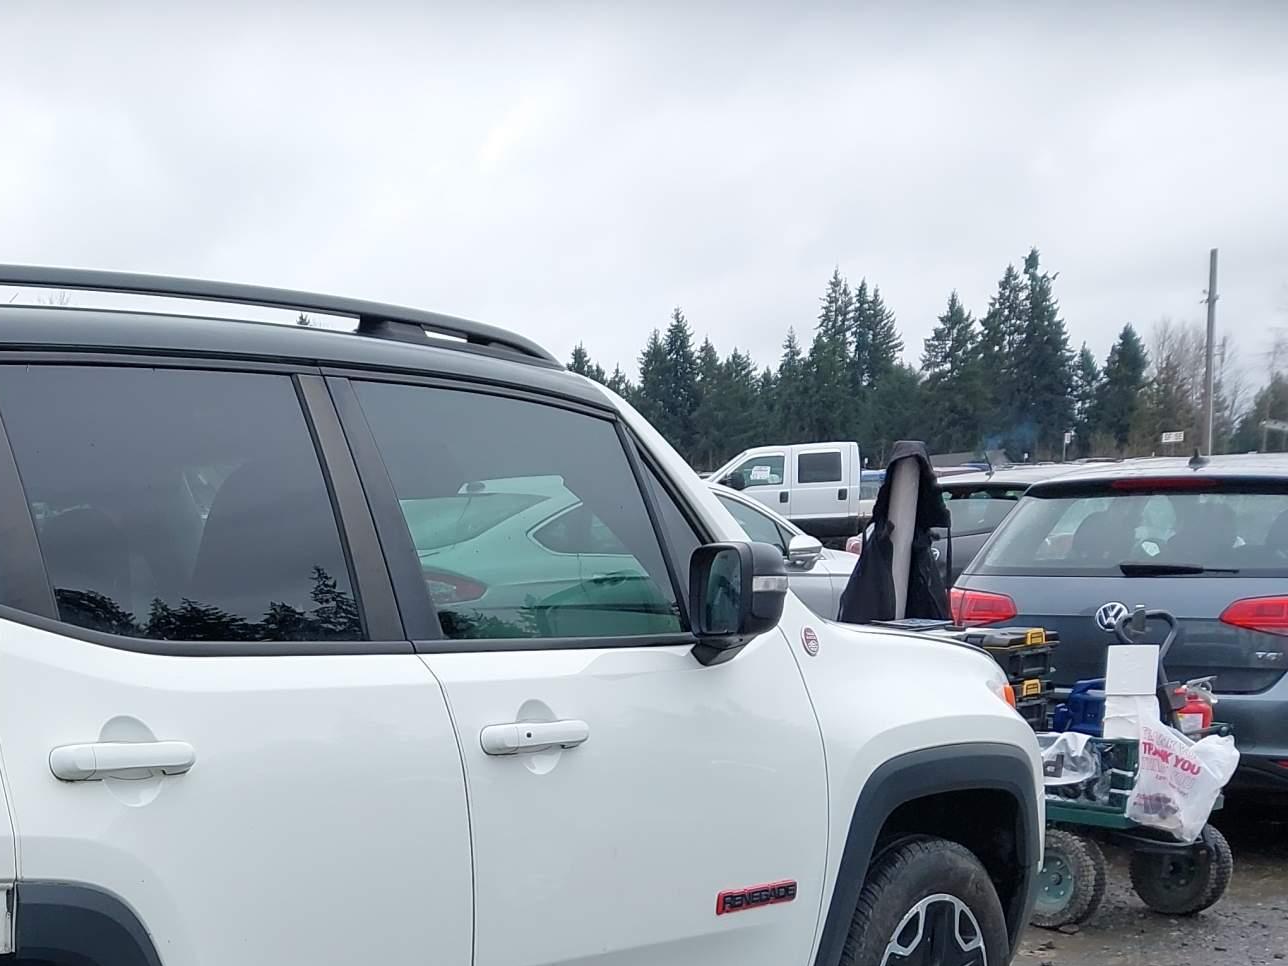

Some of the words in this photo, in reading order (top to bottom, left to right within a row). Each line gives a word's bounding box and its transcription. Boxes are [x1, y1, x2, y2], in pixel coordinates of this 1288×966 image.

[1142, 740, 1173, 764] THANK
[1172, 755, 1201, 775] YOU
[722, 883, 797, 910] RENEGADE
